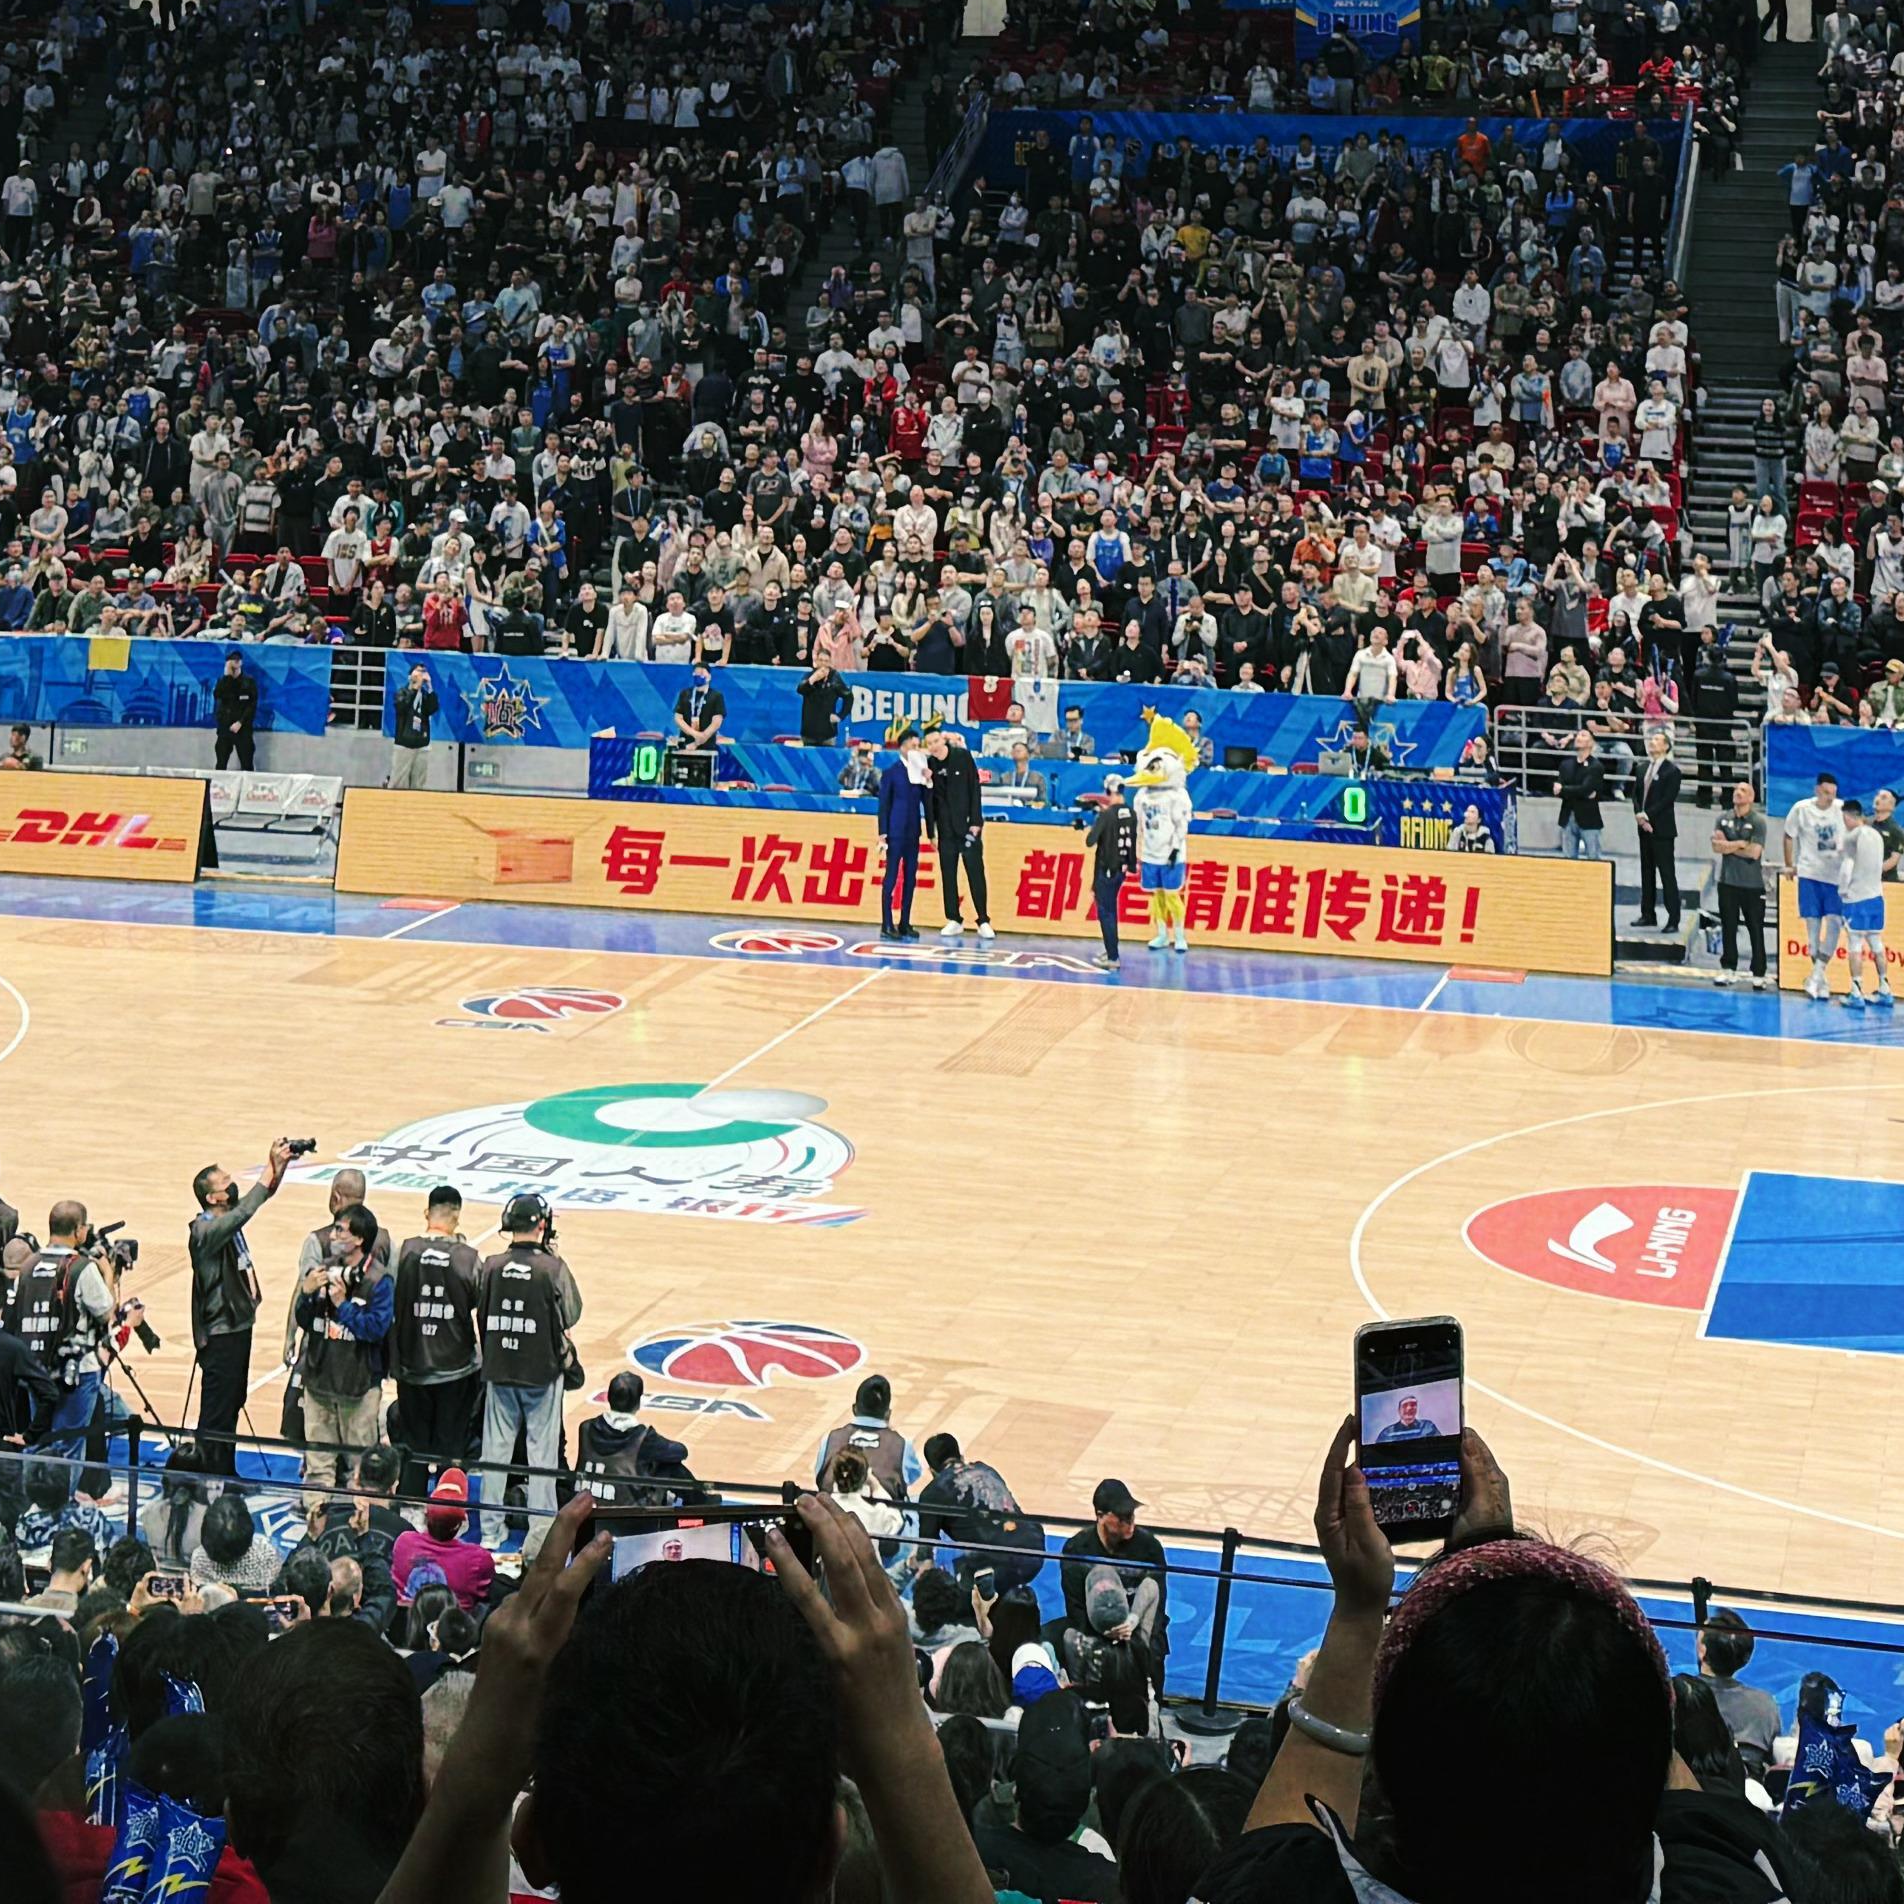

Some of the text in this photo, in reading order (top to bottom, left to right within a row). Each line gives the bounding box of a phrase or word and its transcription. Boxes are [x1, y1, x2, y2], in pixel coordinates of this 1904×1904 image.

[851, 685, 978, 730] BEIJING
[13, 810, 159, 850] DHL
[851, 944, 1102, 973] CBA
[435, 1017, 552, 1033] CBA
[348, 1143, 824, 1198] 中国人寿
[1635, 1206, 1697, 1279] LI-NING
